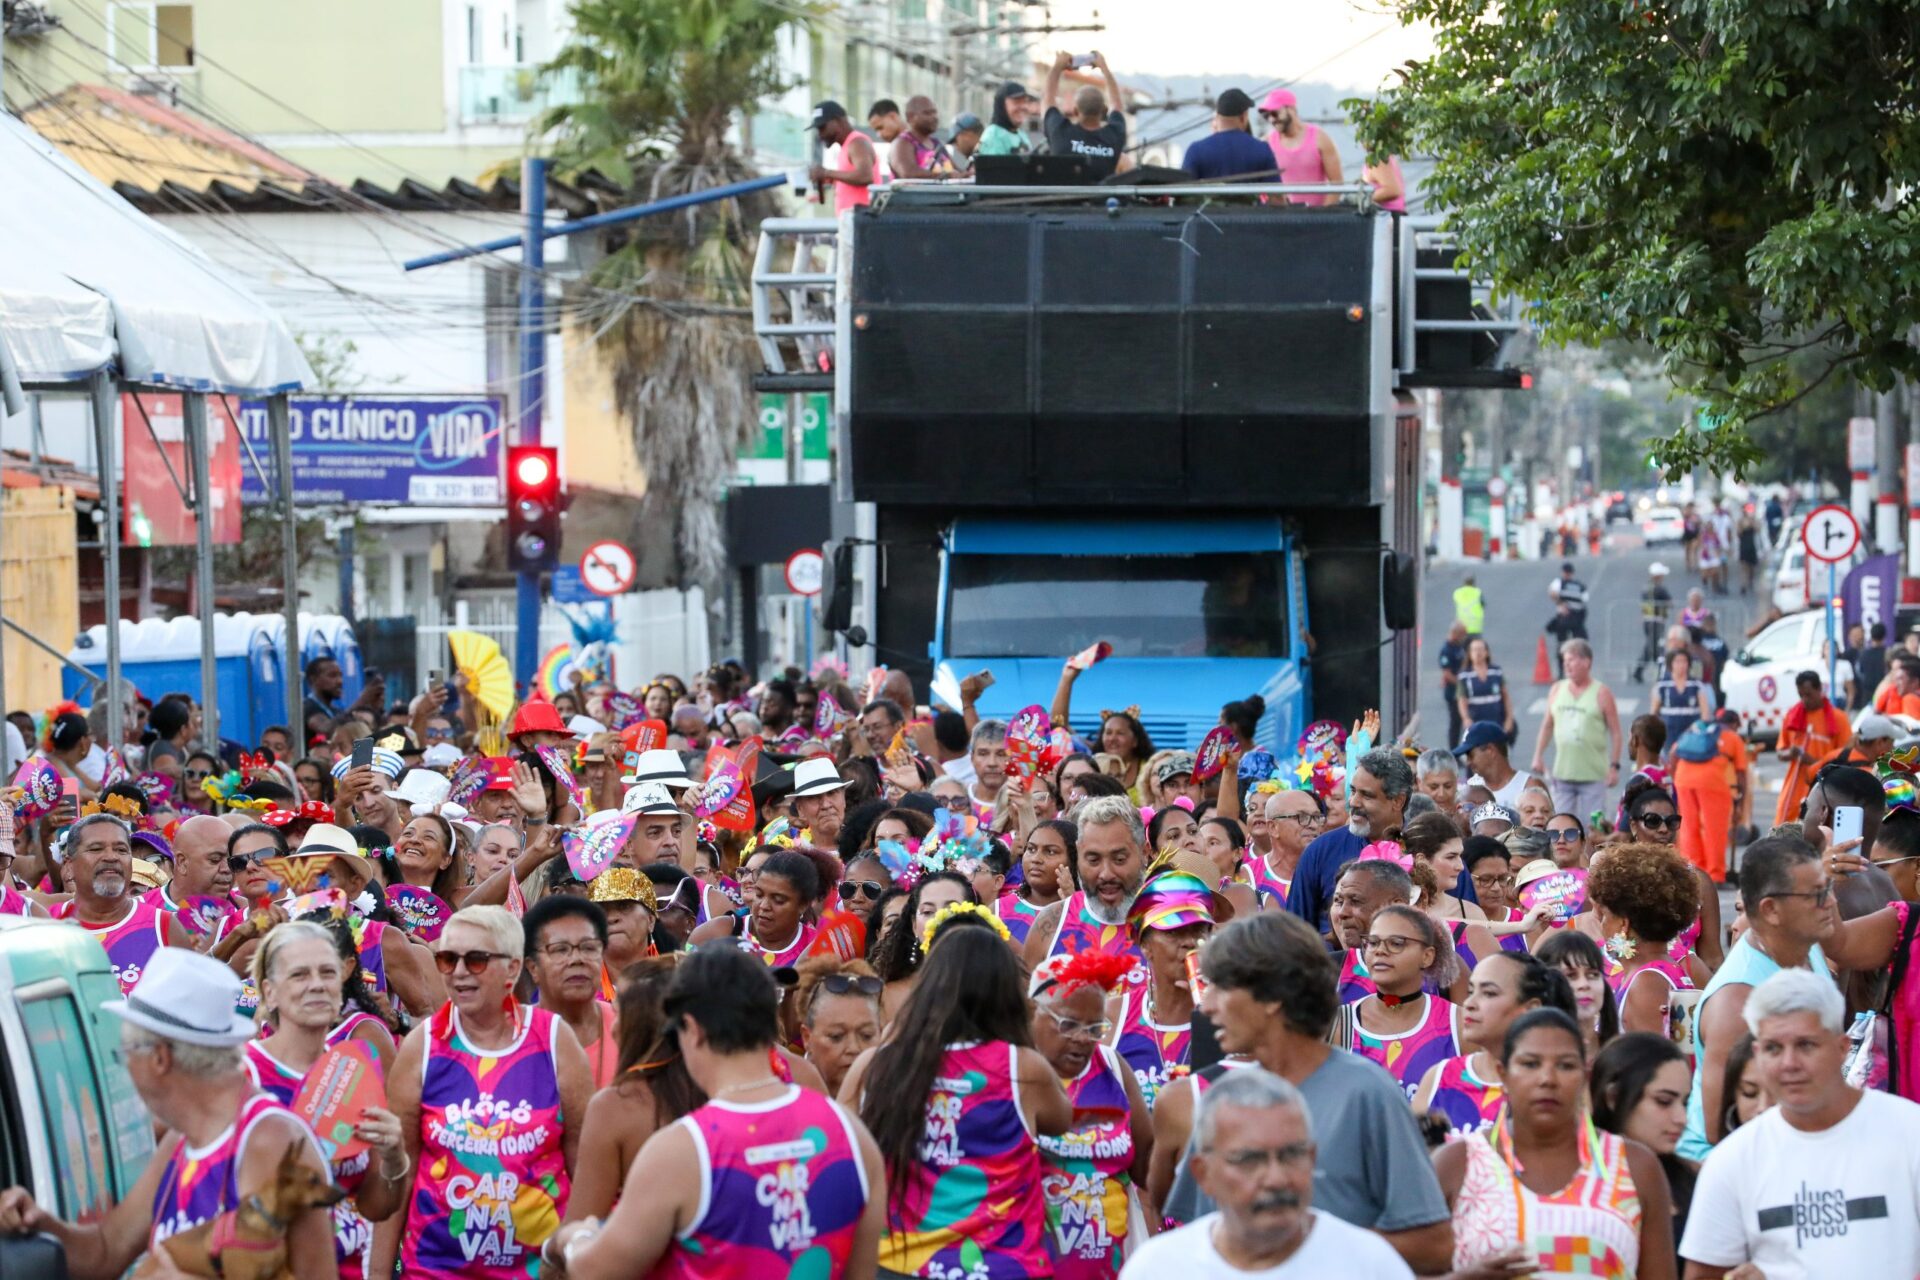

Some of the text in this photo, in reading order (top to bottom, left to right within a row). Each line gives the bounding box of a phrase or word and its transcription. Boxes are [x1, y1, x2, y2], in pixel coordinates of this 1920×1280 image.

[1070, 139, 1115, 157] Técnica
[311, 401, 416, 440] CLÍNICO
[427, 413, 487, 459] VIDA
[445, 1092, 533, 1125] BLOCO
[446, 1171, 519, 1210] CAR
[756, 1162, 810, 1208] CAR
[1041, 1171, 1109, 1205] CAR
[464, 1200, 513, 1231] NA
[1060, 1197, 1104, 1225] NA
[1796, 1203, 1845, 1226] BOSS
[458, 1226, 523, 1262] VAL
[1055, 1218, 1112, 1255] VAL
[1079, 1247, 1106, 1259] 2025
[484, 1255, 514, 1267] 2025
